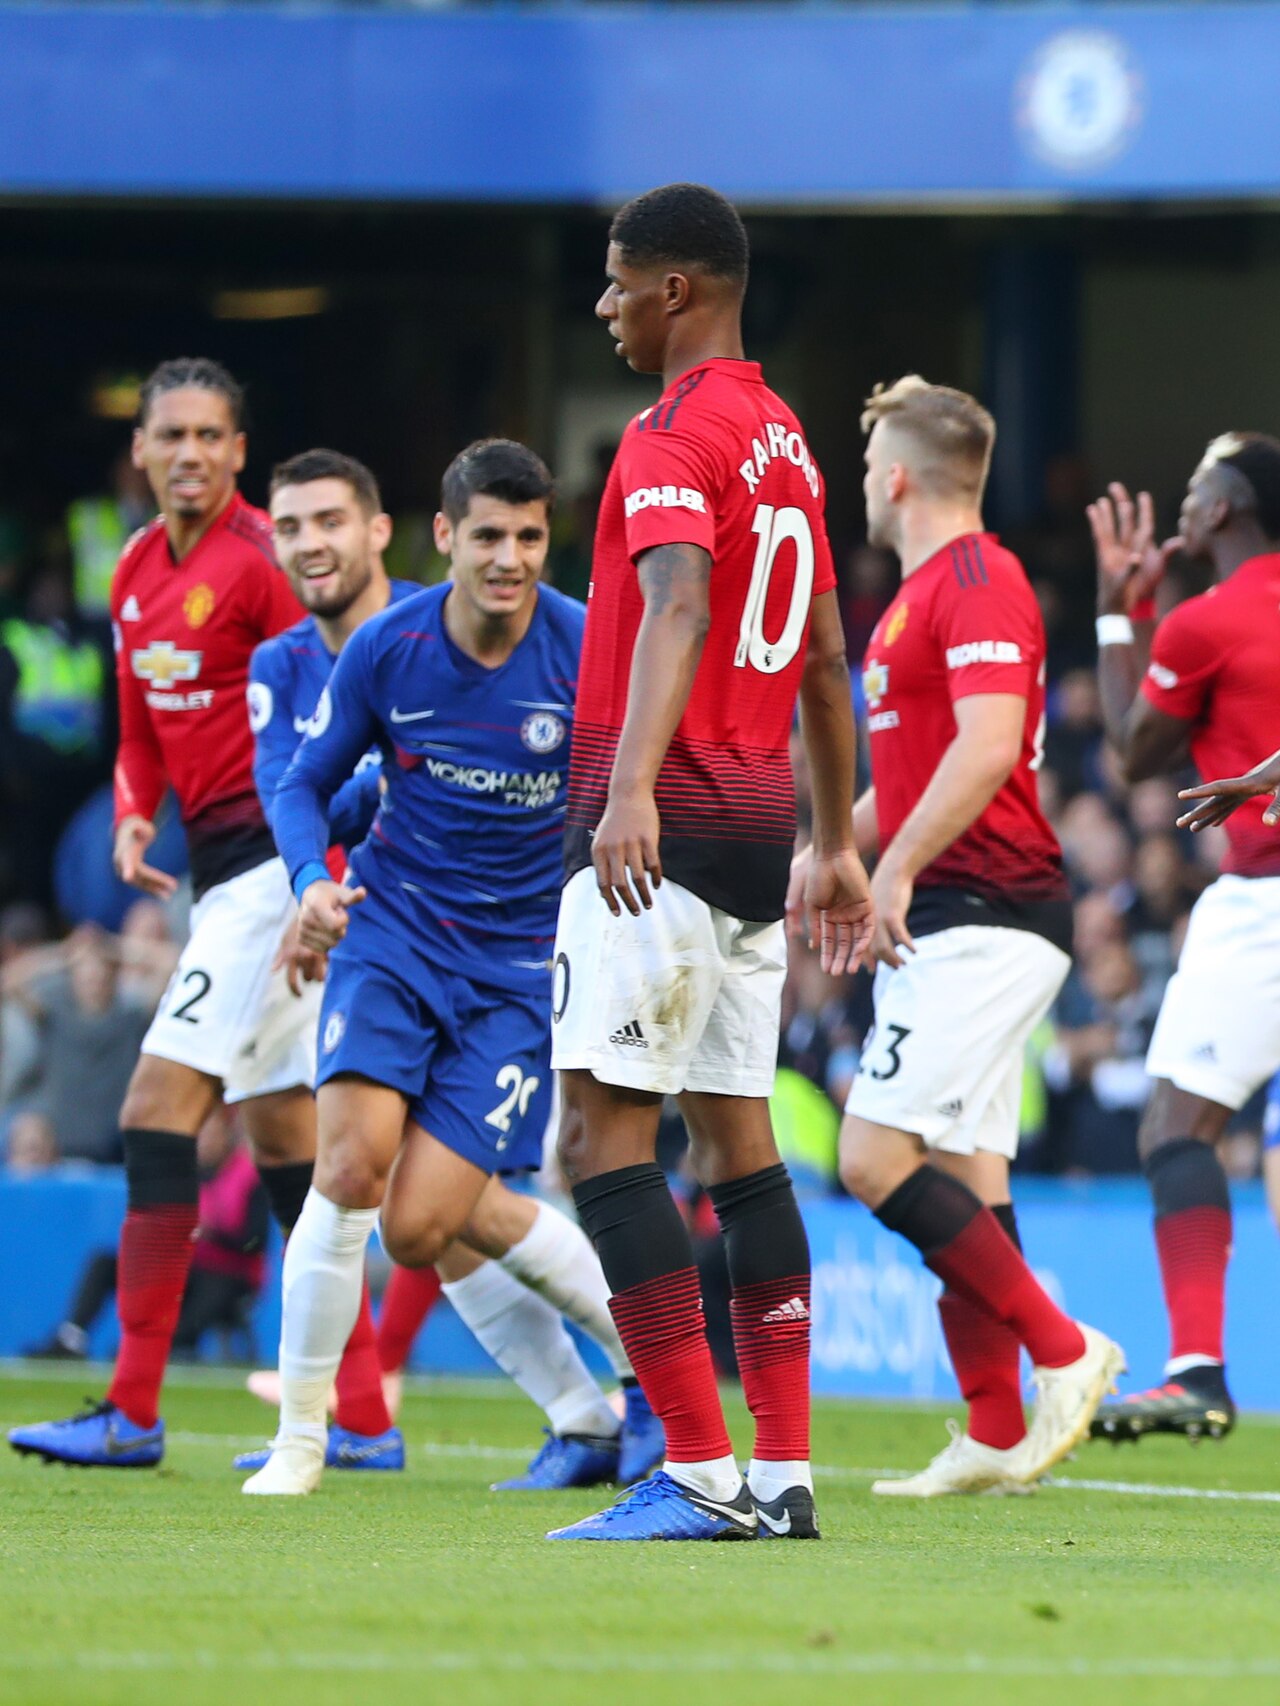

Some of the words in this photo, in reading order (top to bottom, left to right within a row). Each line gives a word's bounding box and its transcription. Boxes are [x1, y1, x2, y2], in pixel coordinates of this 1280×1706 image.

[624, 485, 707, 518] KOHLER
[733, 503, 815, 674] 10
[425, 757, 562, 793] YOKOHAMA
[609, 1034, 650, 1049] adidas
[859, 1023, 912, 1081] 3
